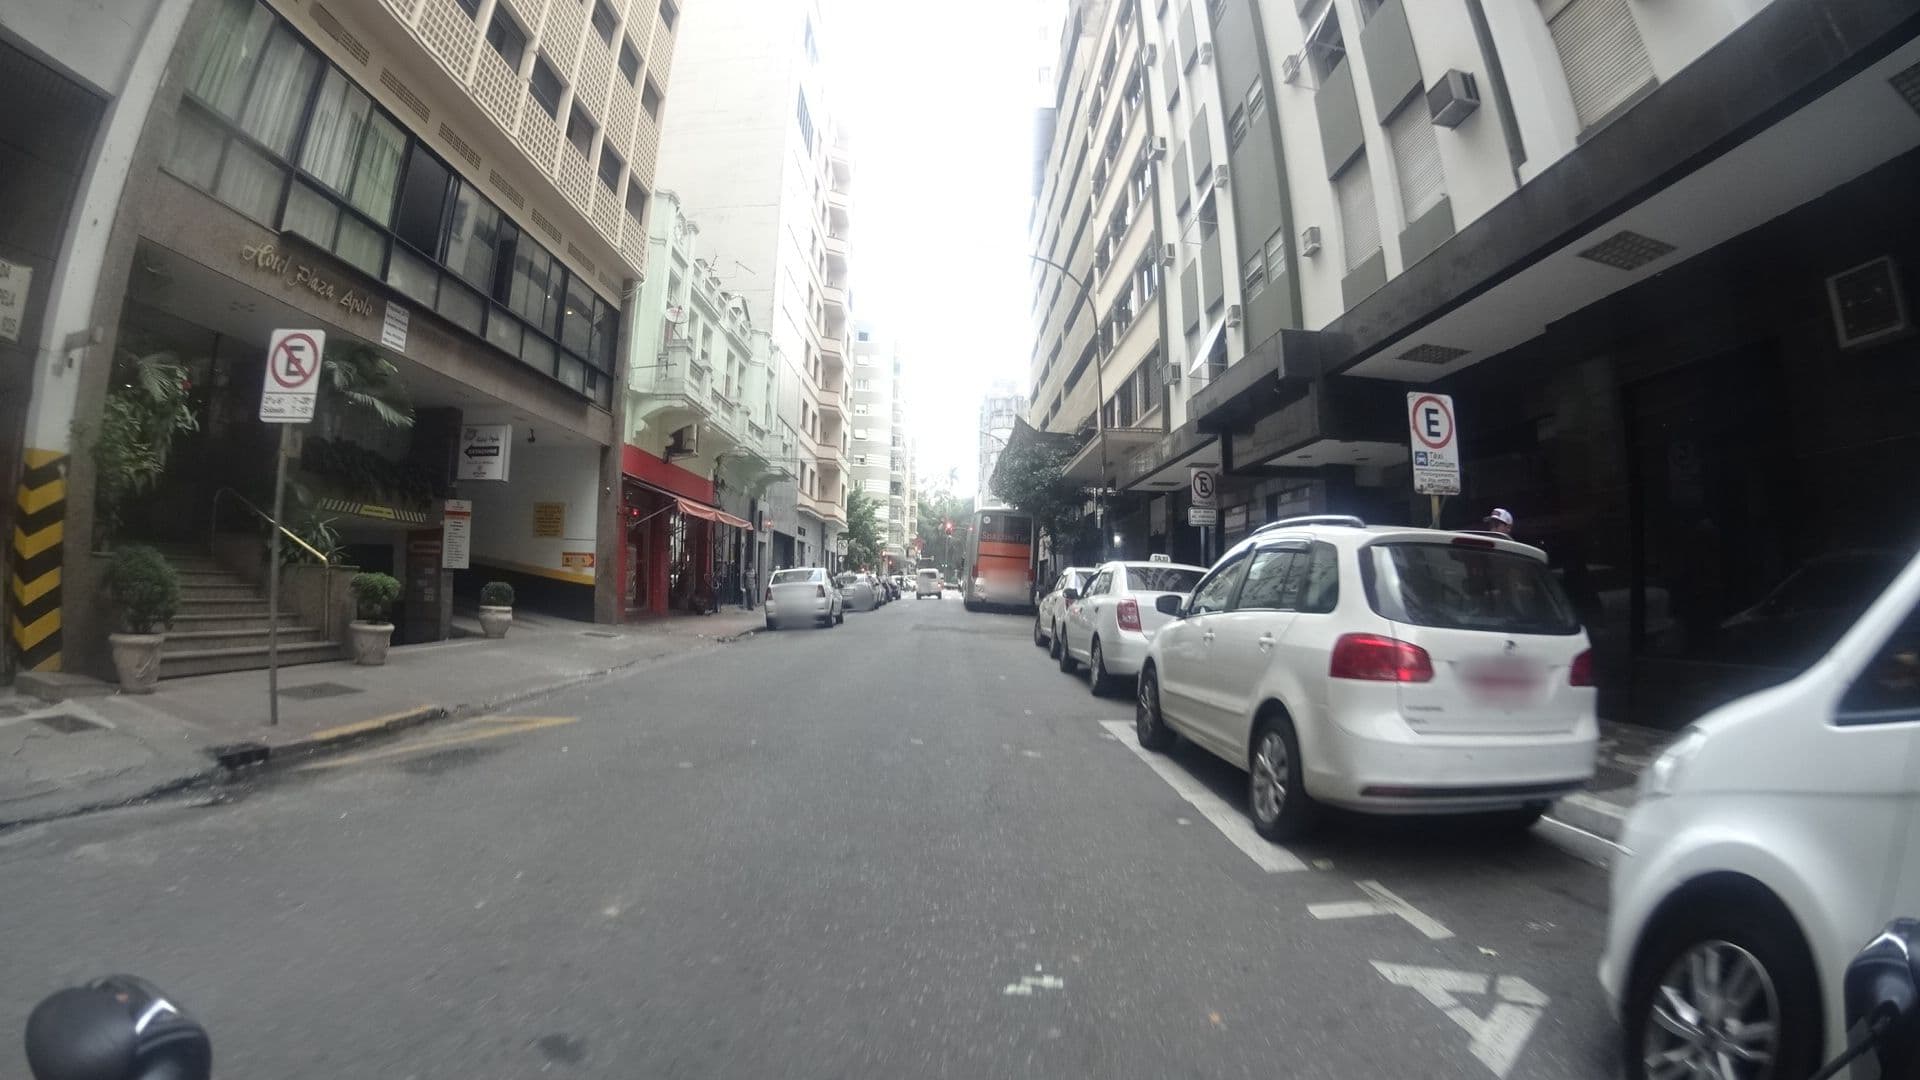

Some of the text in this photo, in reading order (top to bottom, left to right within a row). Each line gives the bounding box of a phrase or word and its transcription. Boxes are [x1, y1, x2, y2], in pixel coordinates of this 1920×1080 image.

[242, 242, 373, 317] Hotel Plaza Apolo
[285, 345, 305, 376] E
[1424, 407, 1441, 438] E
